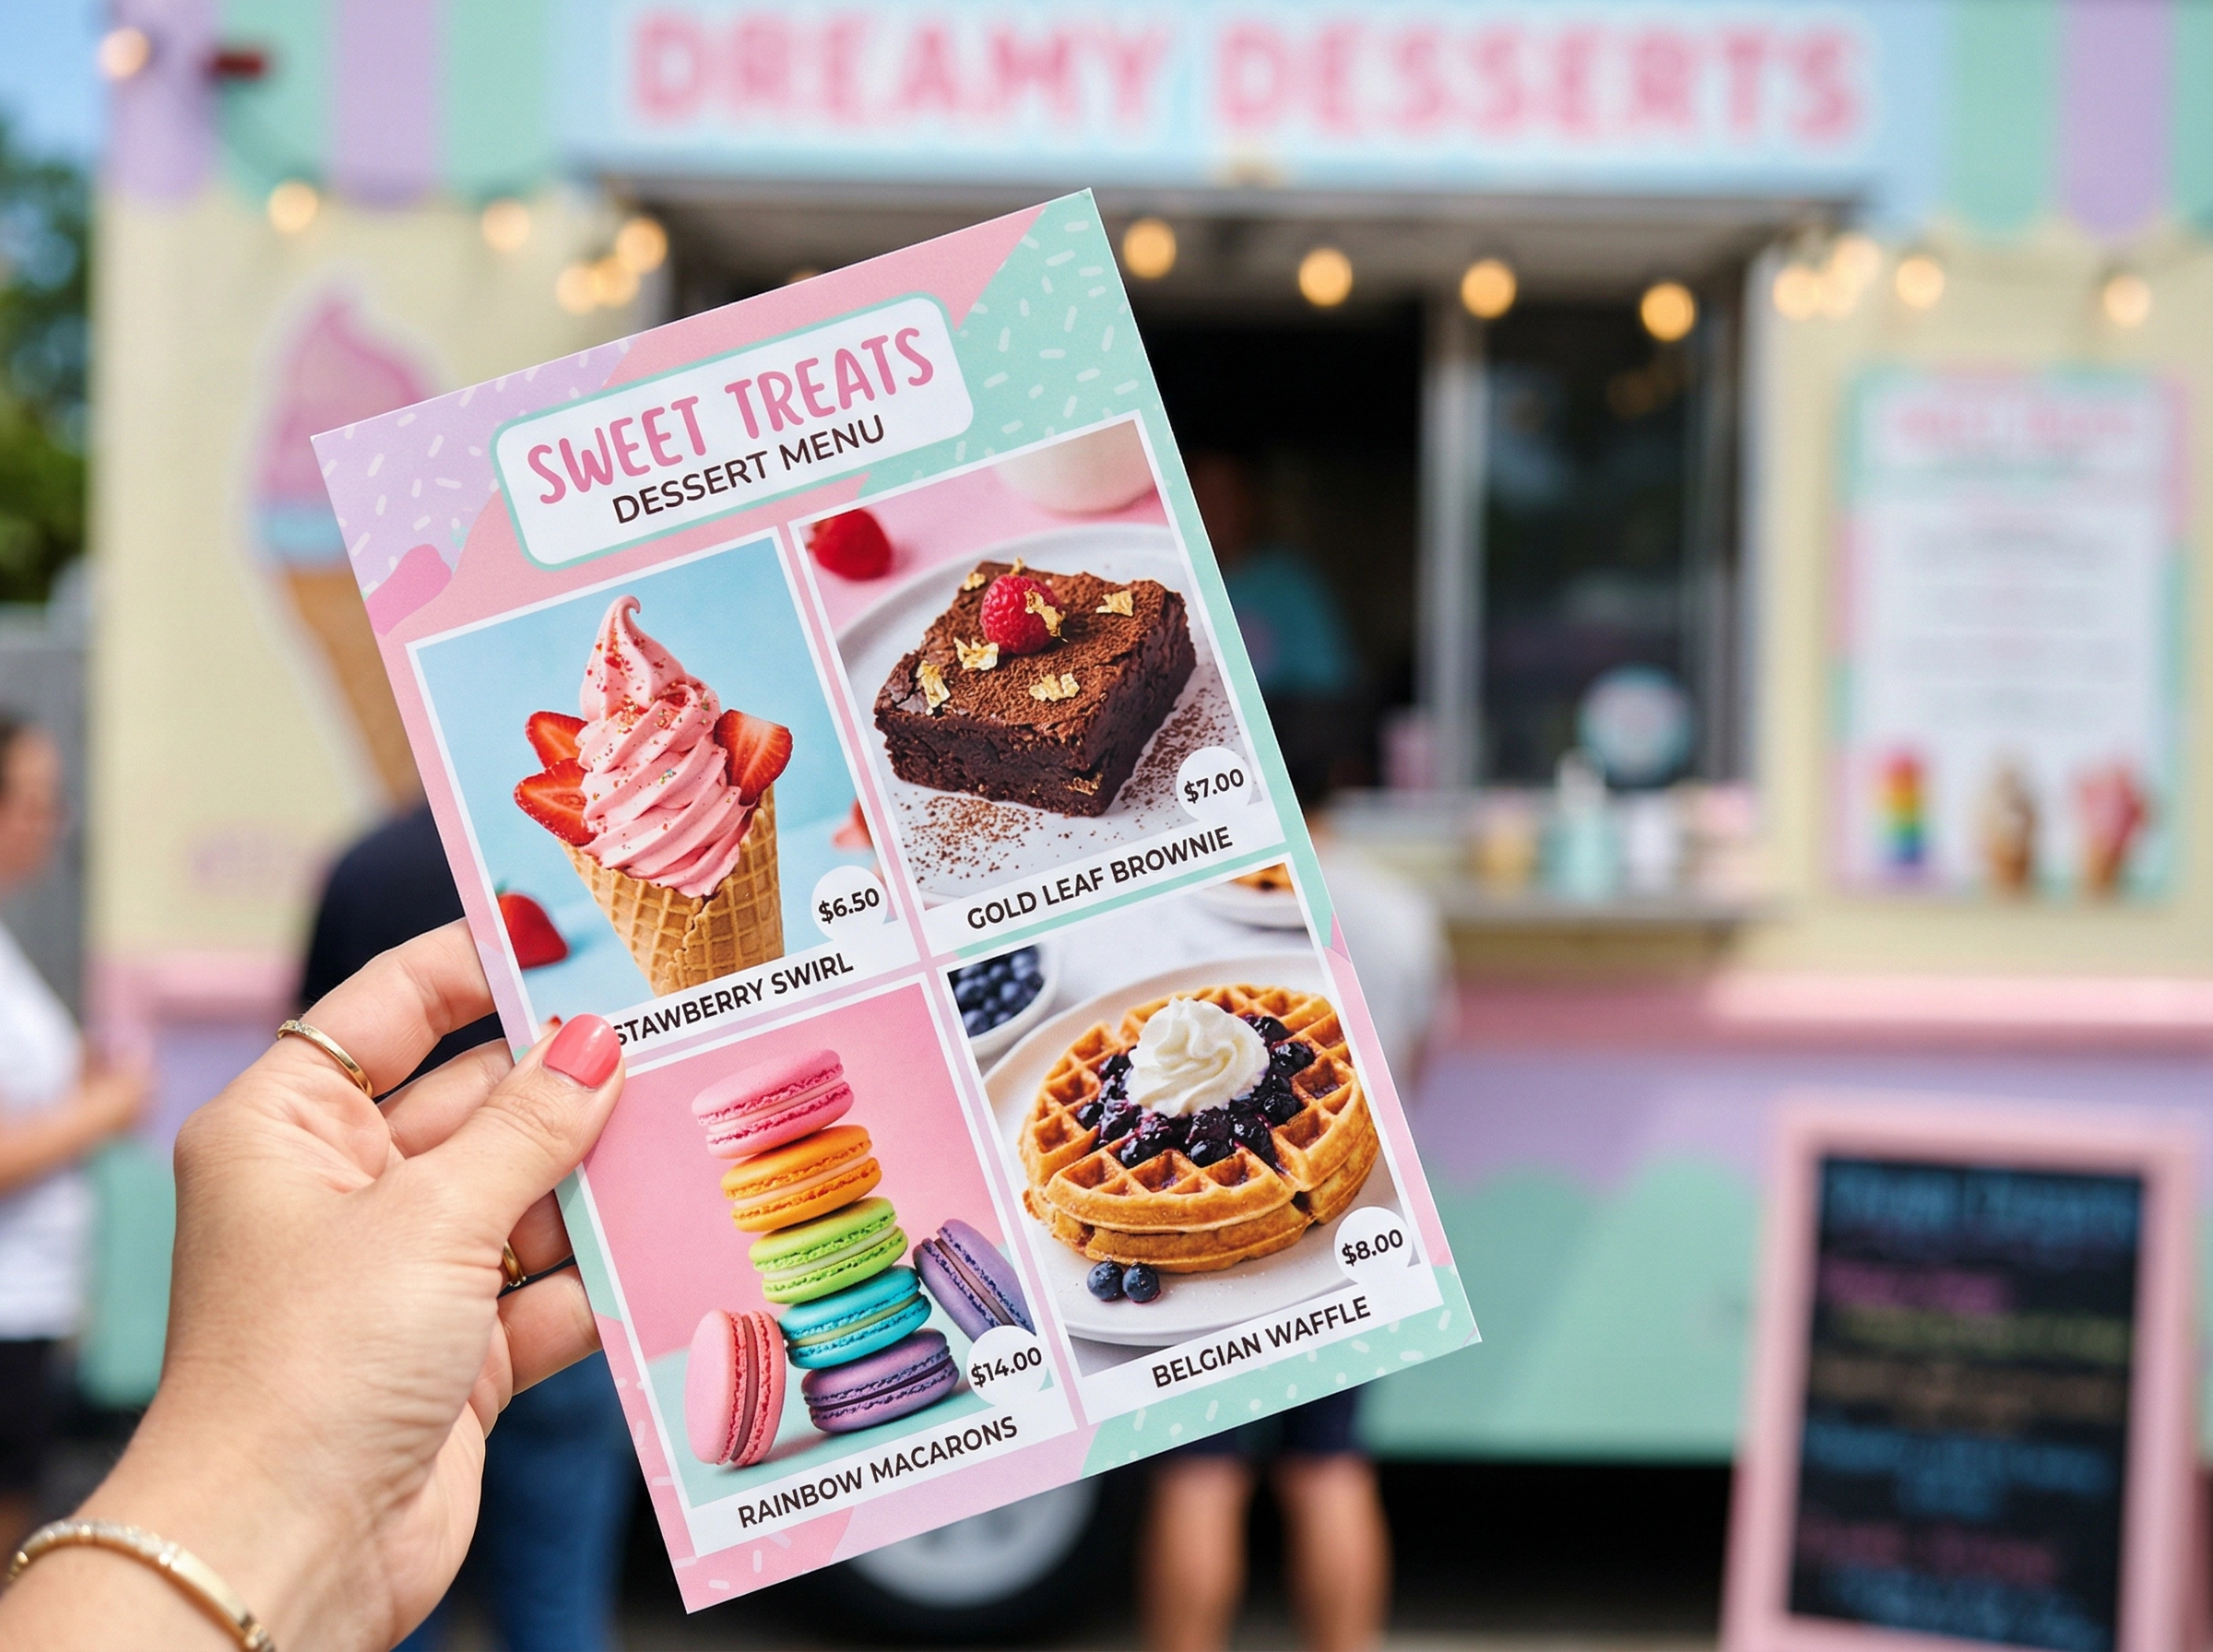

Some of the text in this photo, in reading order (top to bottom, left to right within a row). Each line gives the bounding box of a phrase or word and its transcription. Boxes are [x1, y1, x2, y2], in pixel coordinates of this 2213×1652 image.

[630, 11, 1856, 141] DREAMY DESSERTS
[527, 327, 934, 504] SWEET TREATS
[612, 414, 885, 525] DESSERT MENU
[1183, 768, 1244, 805] $7.00
[818, 888, 880, 925] $6.50
[967, 826, 1233, 929] GOLD LEAF BROWNIE
[613, 952, 854, 1046] STAWBERRY SWIRL
[1342, 1229, 1403, 1267] $8.00
[970, 1347, 1042, 1388] $14.00
[1152, 1295, 1371, 1388] BELGIAN WAFFLE
[738, 1415, 1018, 1528] RAINBOW MACARONS
